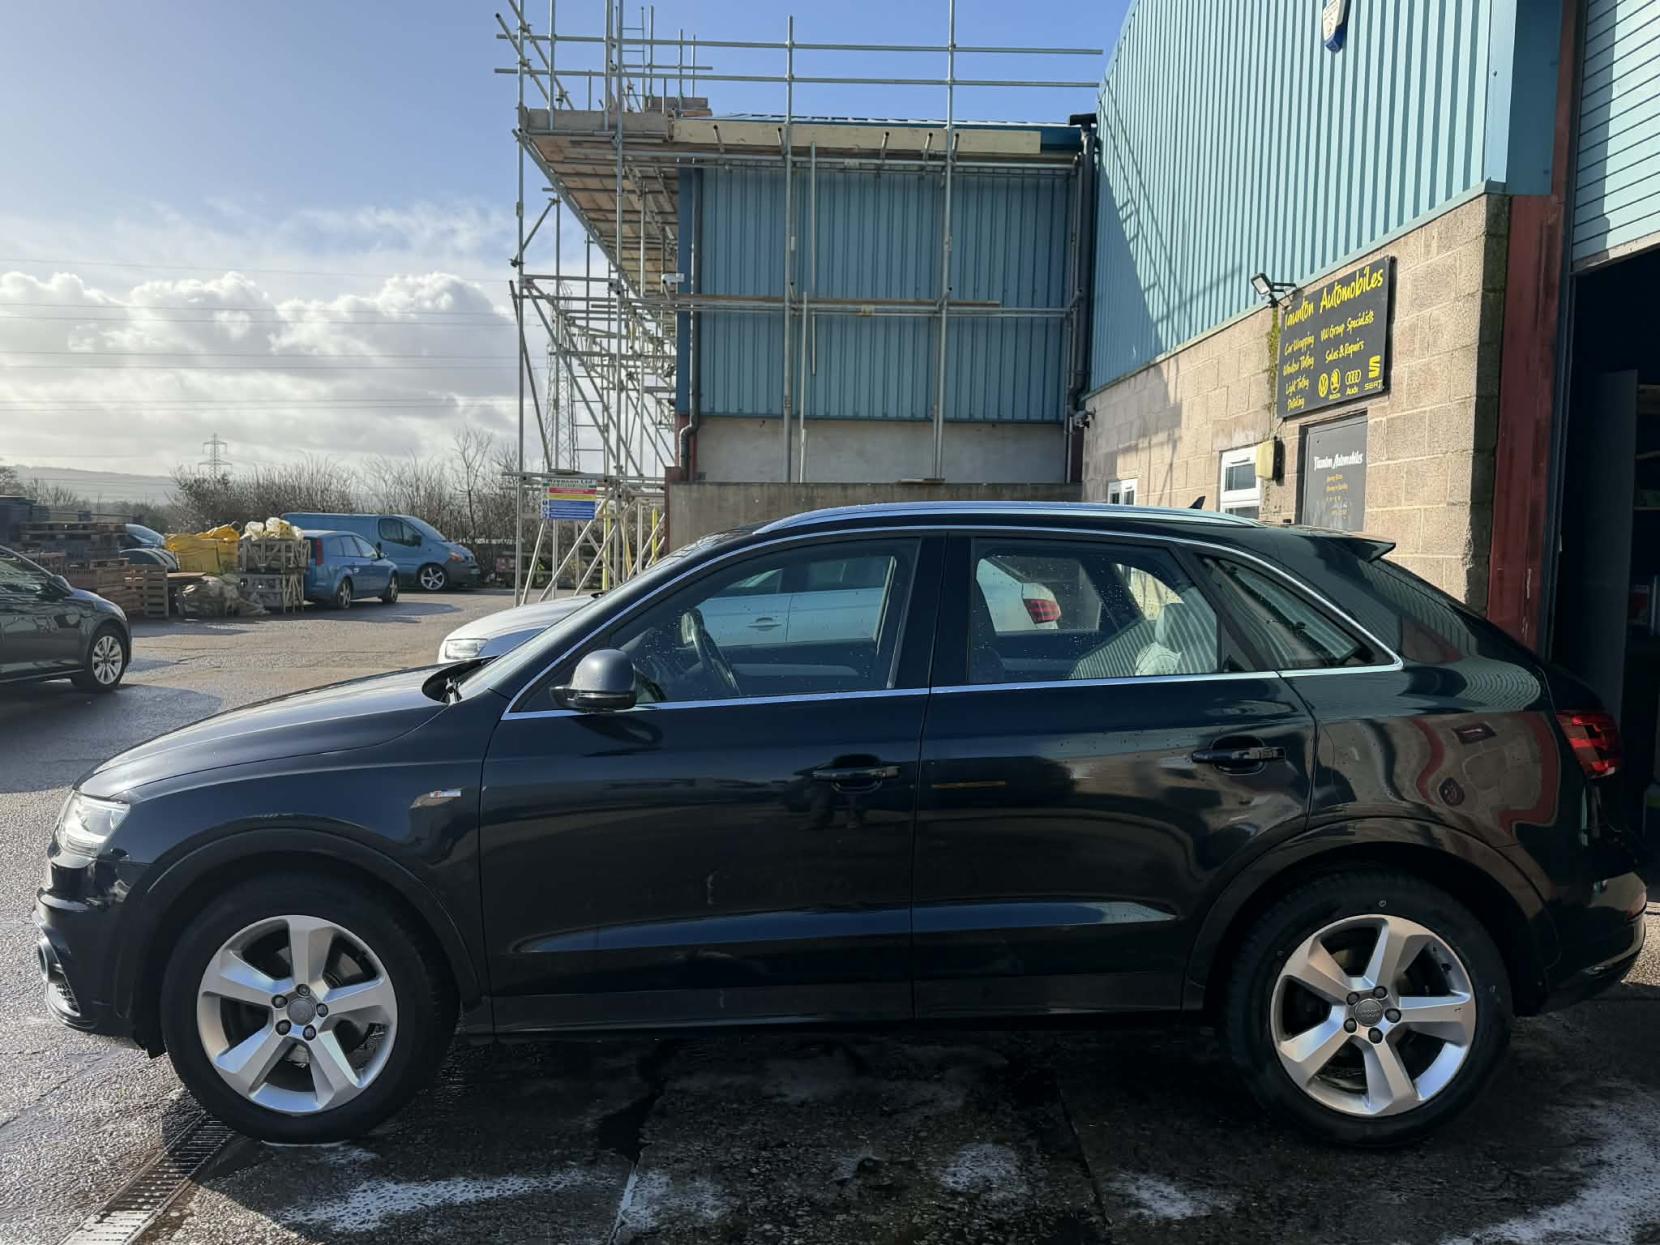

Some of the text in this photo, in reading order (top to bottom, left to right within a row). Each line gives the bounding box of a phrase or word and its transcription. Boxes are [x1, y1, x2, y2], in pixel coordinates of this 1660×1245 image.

[1320, 265, 1384, 313] Automobiles
[1345, 385, 1359, 396] Audi
[1364, 379, 1383, 391] SEAT
